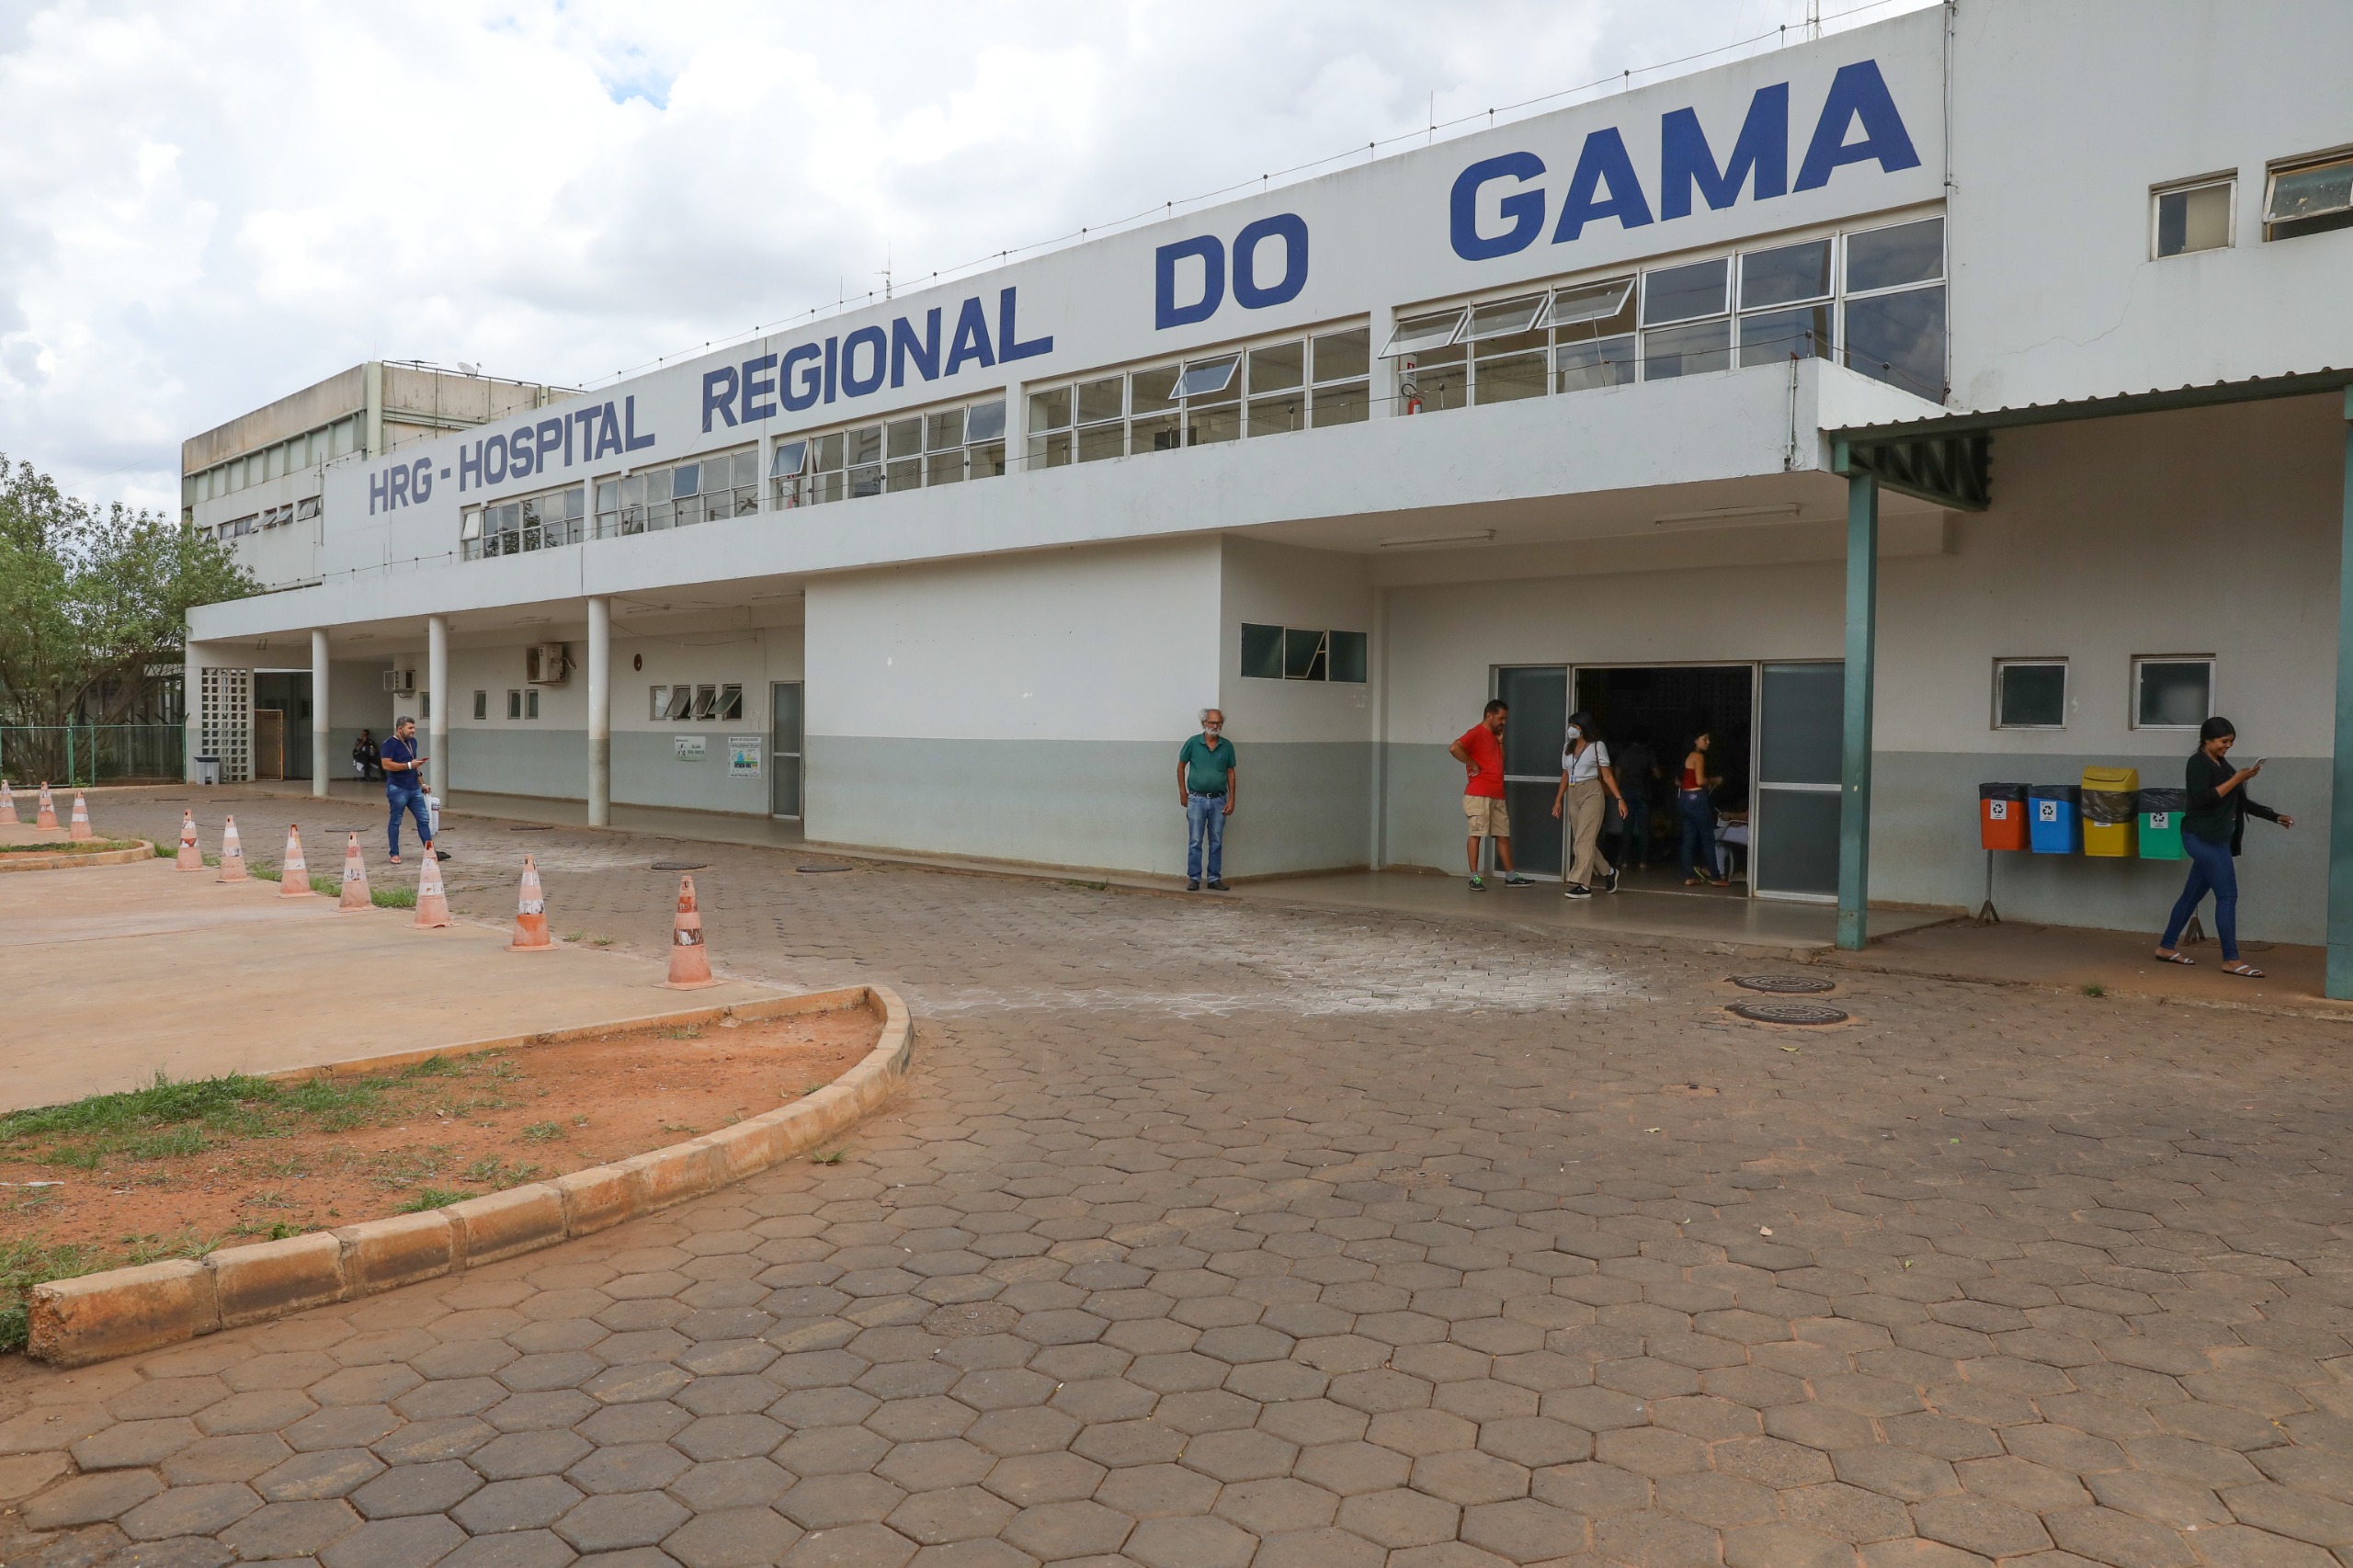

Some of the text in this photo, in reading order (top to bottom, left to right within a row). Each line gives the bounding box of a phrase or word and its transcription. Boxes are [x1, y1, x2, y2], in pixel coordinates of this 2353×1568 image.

[369, 457, 432, 516] HRG
[460, 395, 655, 492] HOSPITAL
[702, 286, 1053, 433] REGIONAL
[1155, 212, 1309, 331] DO
[1449, 59, 1922, 262] GAMA
